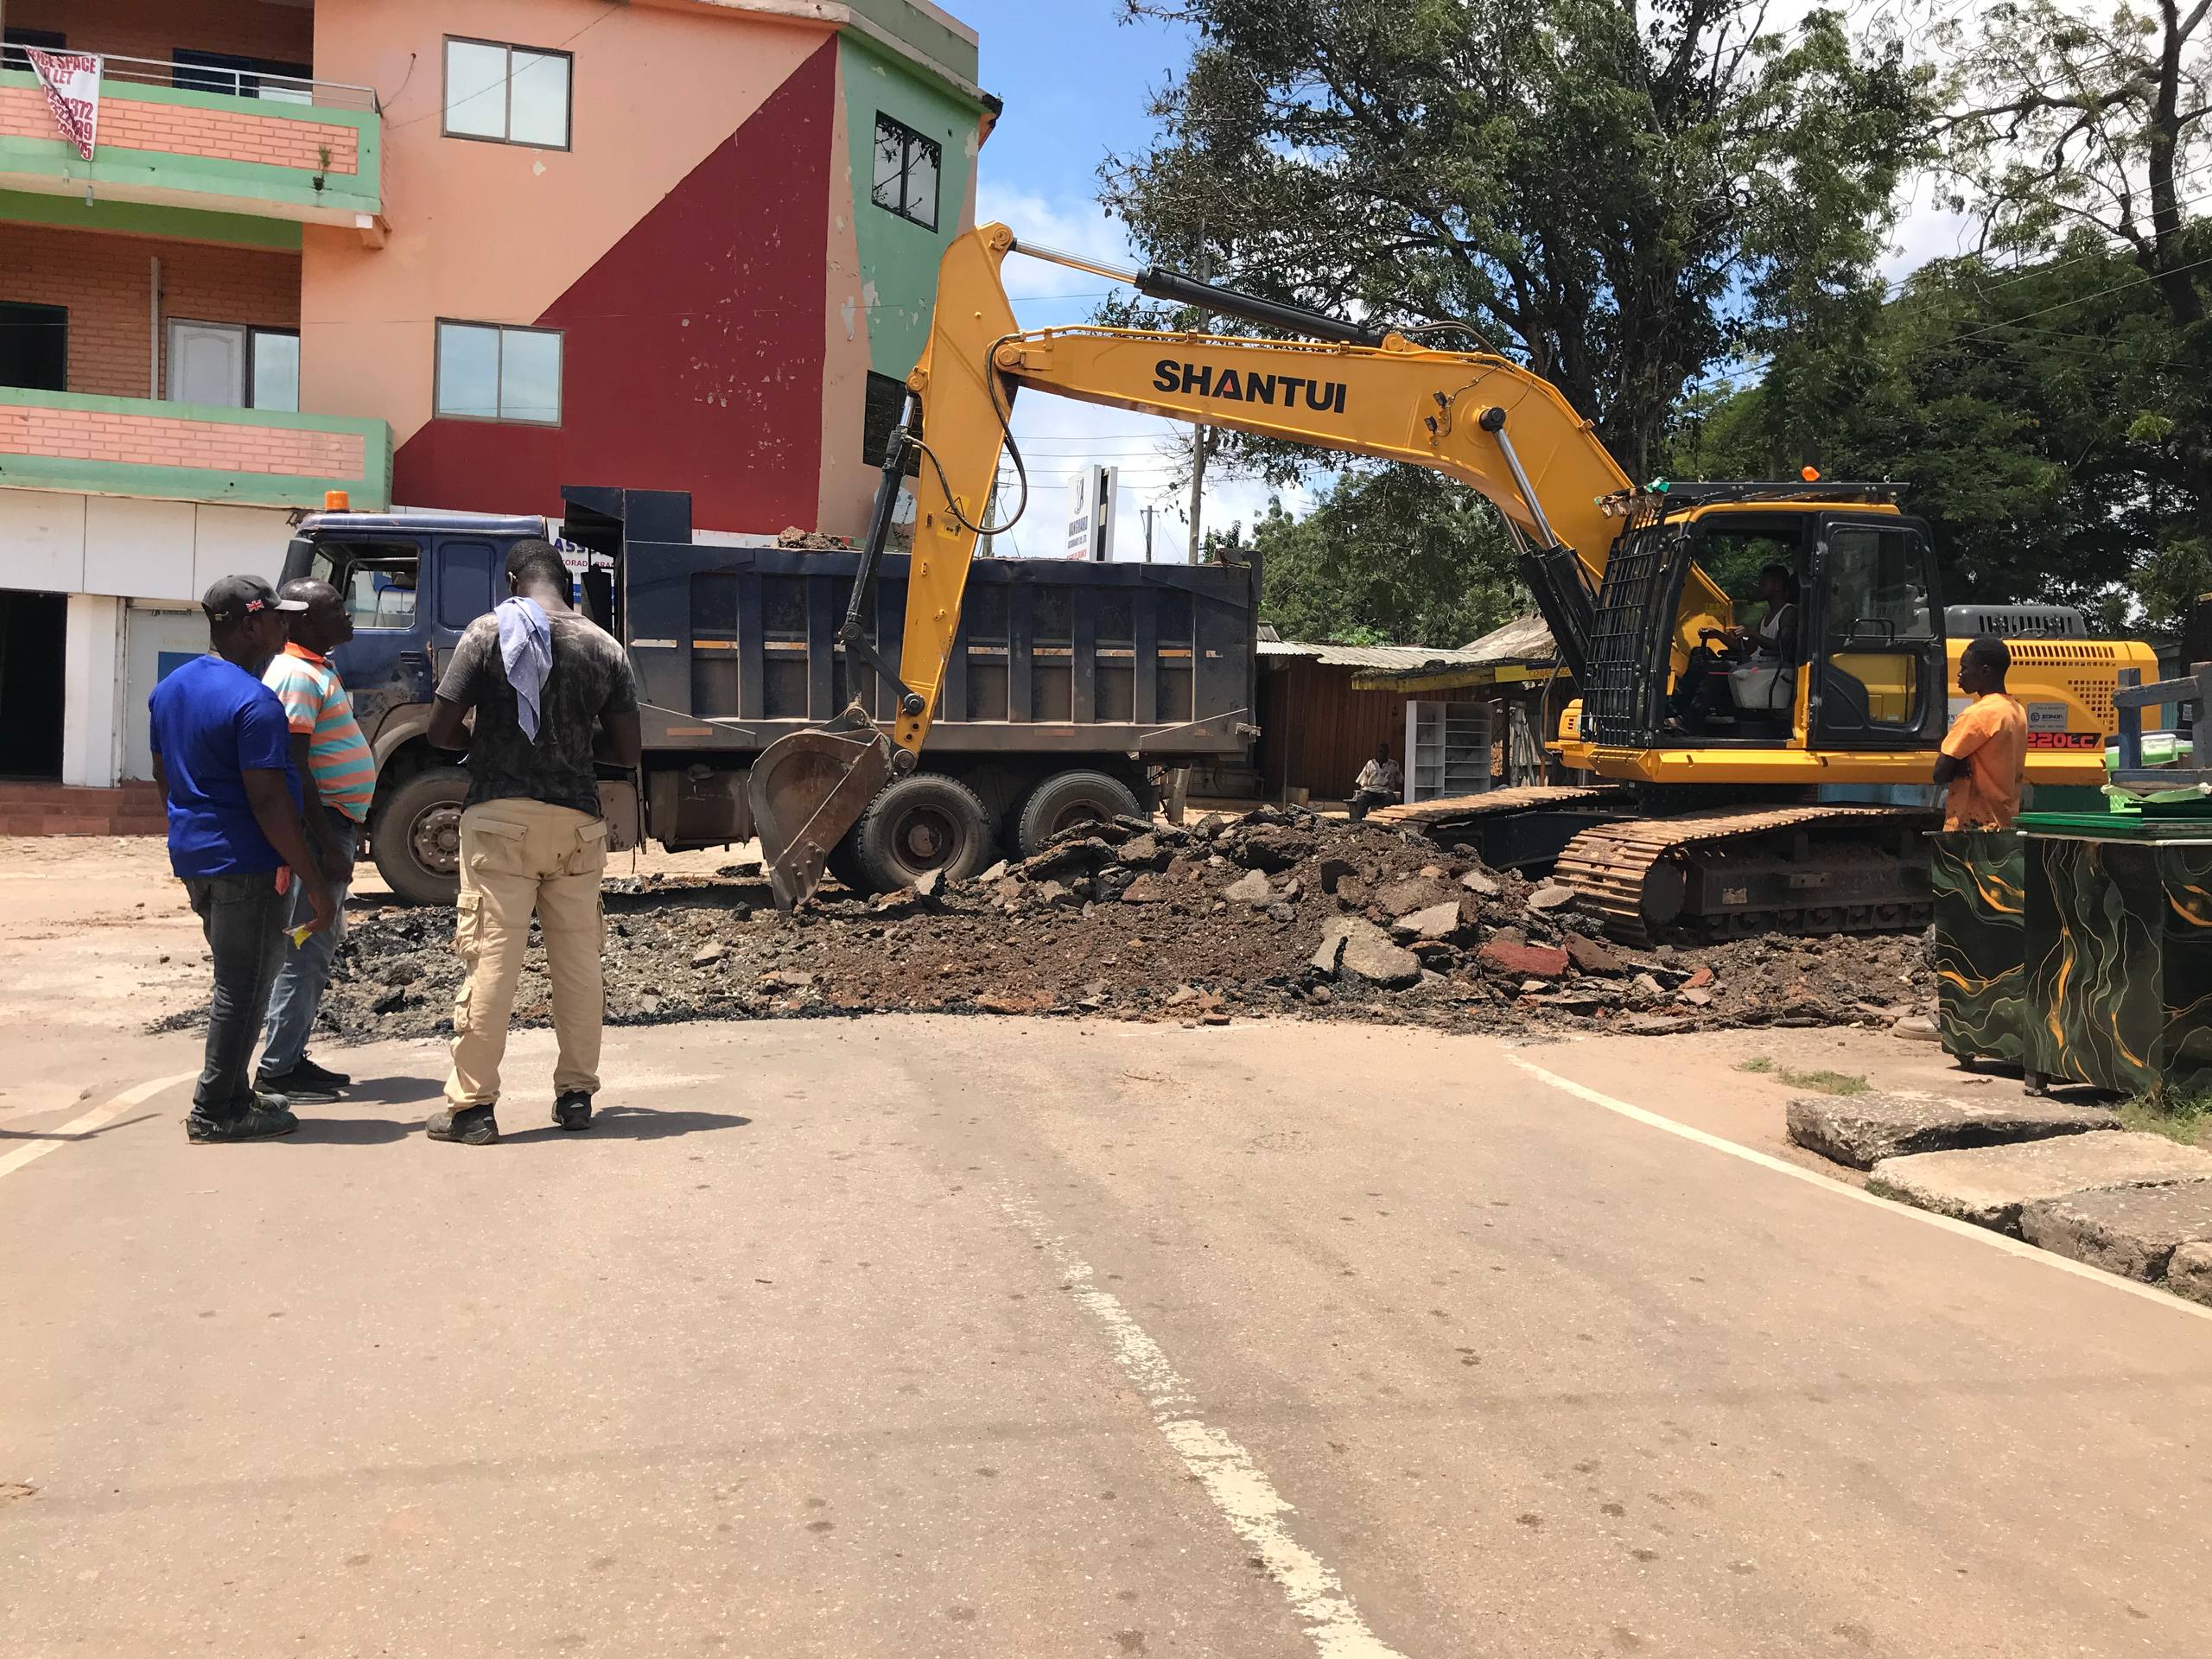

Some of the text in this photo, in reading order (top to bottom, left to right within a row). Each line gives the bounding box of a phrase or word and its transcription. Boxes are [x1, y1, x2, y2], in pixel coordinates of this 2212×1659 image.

[56, 55, 97, 74] SPACE
[53, 69, 74, 85] LET
[1153, 359, 1347, 414] SHANTUI
